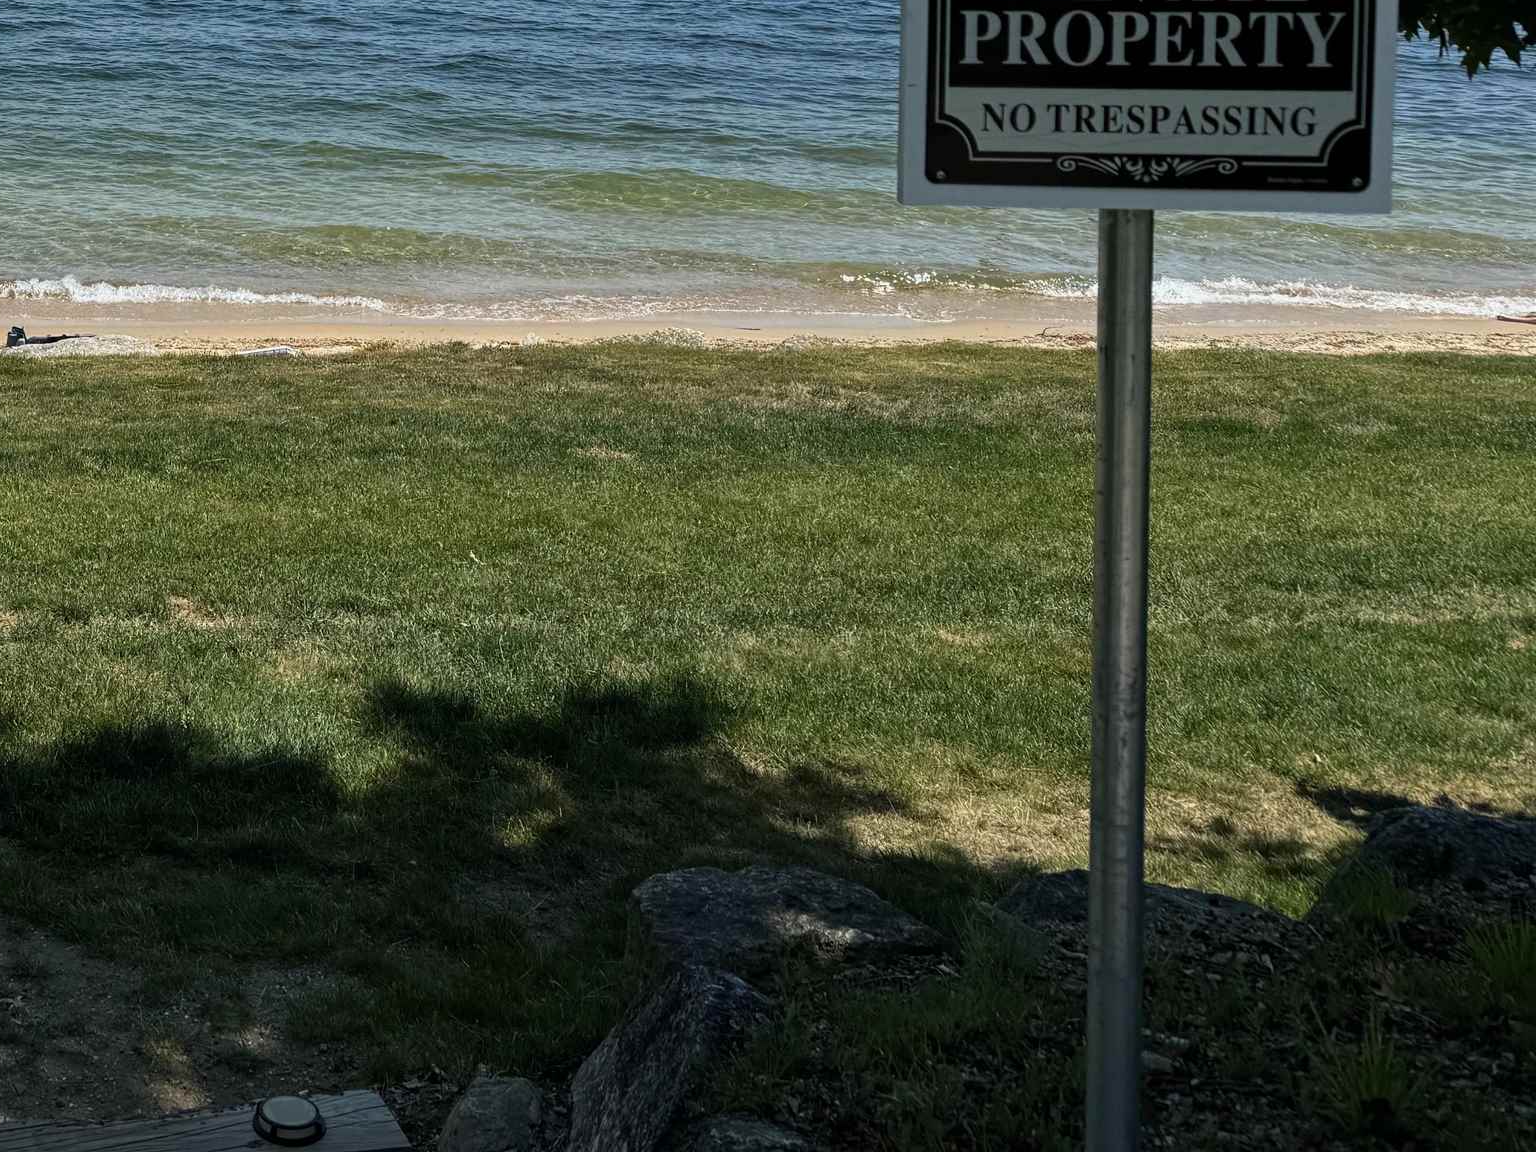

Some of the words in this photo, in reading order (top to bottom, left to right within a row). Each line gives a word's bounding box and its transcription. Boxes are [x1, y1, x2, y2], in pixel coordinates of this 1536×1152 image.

[959, 9, 1346, 68] PROPERTY
[982, 103, 1036, 133] NO
[1046, 104, 1316, 137] TRESPASSING
